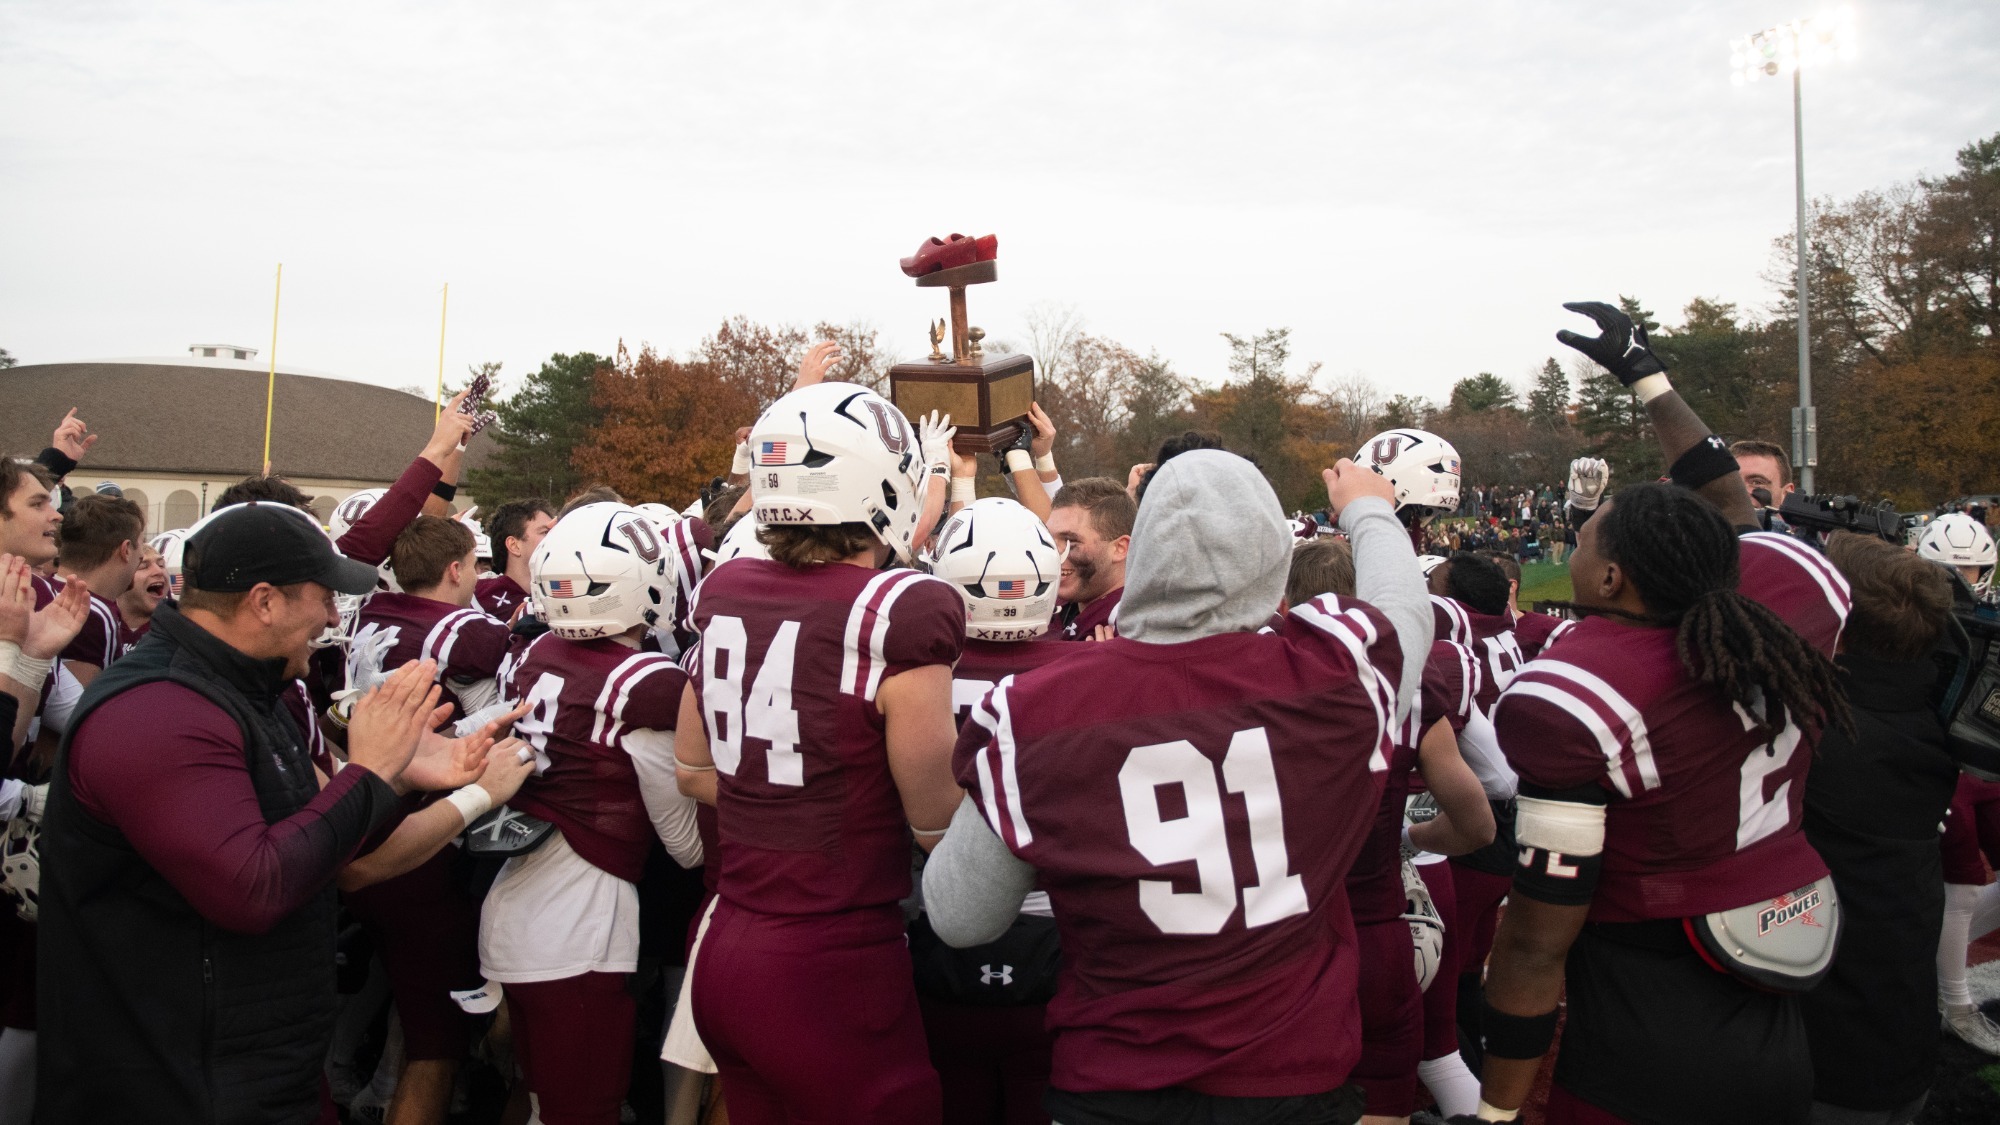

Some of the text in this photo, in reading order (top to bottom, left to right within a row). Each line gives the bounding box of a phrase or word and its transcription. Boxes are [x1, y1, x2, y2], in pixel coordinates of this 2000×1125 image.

[863, 399, 911, 456] U
[1371, 436, 1402, 467] U
[616, 517, 661, 564] U
[1003, 608, 1017, 617] 39
[702, 614, 804, 787] 84
[1117, 726, 1310, 935] 91
[1759, 890, 1821, 936] POWER
